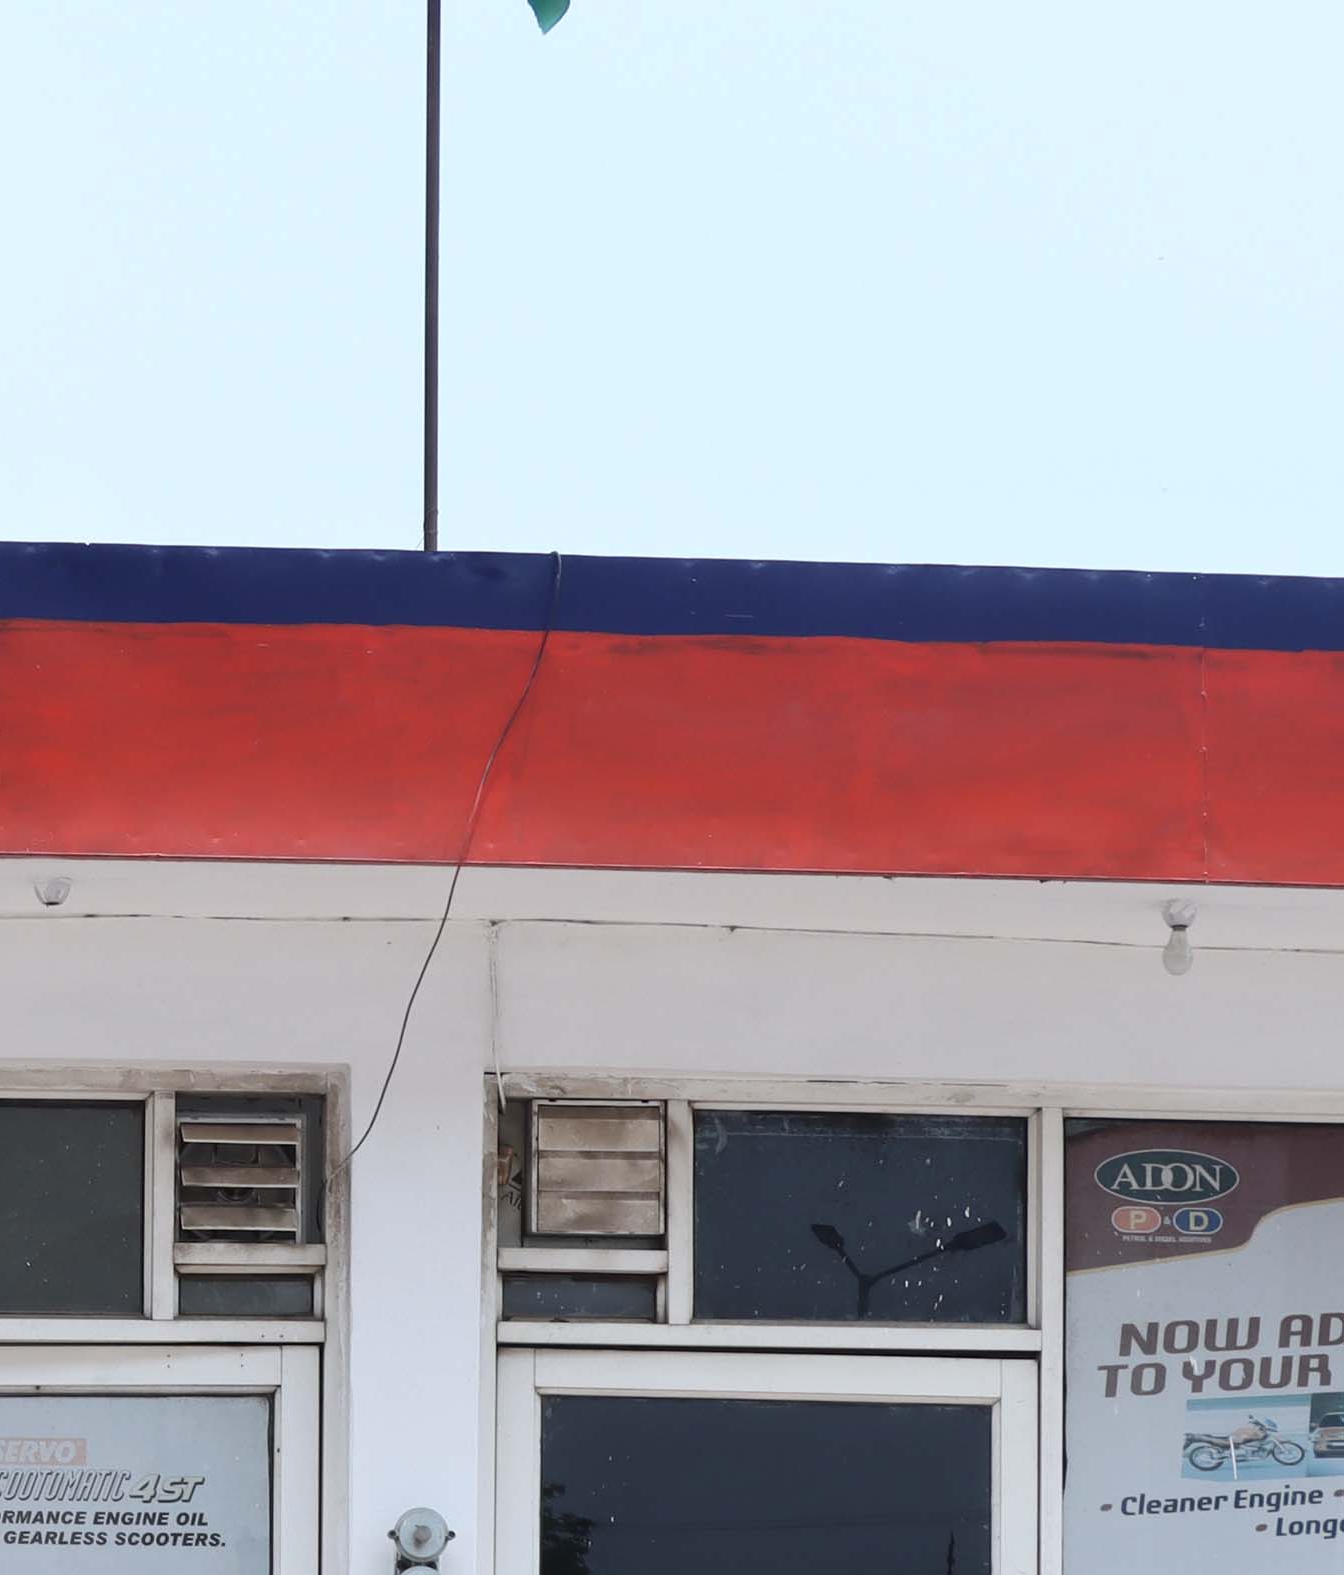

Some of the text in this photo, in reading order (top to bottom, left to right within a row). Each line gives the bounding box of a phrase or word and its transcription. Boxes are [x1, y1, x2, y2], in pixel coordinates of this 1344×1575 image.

[1110, 1161, 1224, 1193] ADON
[1126, 1210, 1147, 1231] P
[1189, 1211, 1210, 1231] D
[1118, 1316, 1261, 1357] NOW
[1097, 1353, 1332, 1399] TO YOUR
[128, 1473, 205, 1503] 4ST
[1120, 1485, 1324, 1516] Cleaner Engine
[93, 1512, 169, 1526] ENGINE
[175, 1512, 209, 1526] OIL
[4, 1531, 108, 1546] GEARLESS
[114, 1532, 226, 1547] SCOOTERS.
